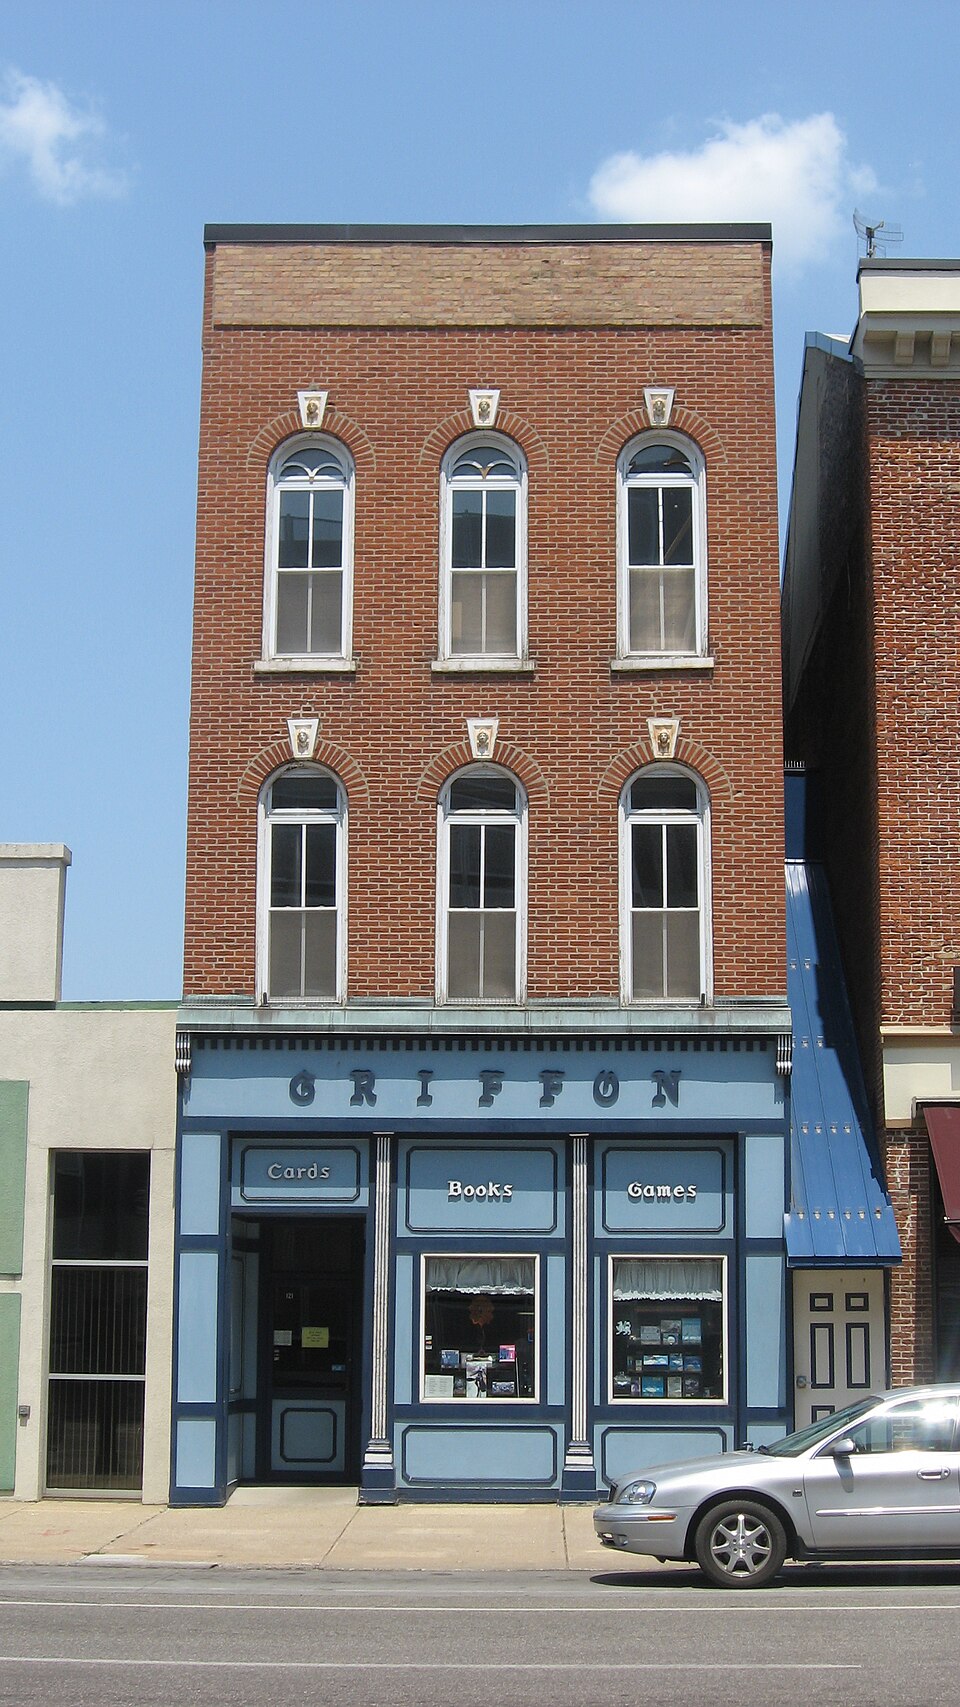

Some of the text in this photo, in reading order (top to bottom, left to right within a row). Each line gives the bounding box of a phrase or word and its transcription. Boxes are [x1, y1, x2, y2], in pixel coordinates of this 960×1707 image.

[289, 1070, 680, 1107] GRIFFON
[267, 1162, 330, 1179] Cards
[447, 1180, 513, 1197] Books
[627, 1181, 697, 1198] Games
